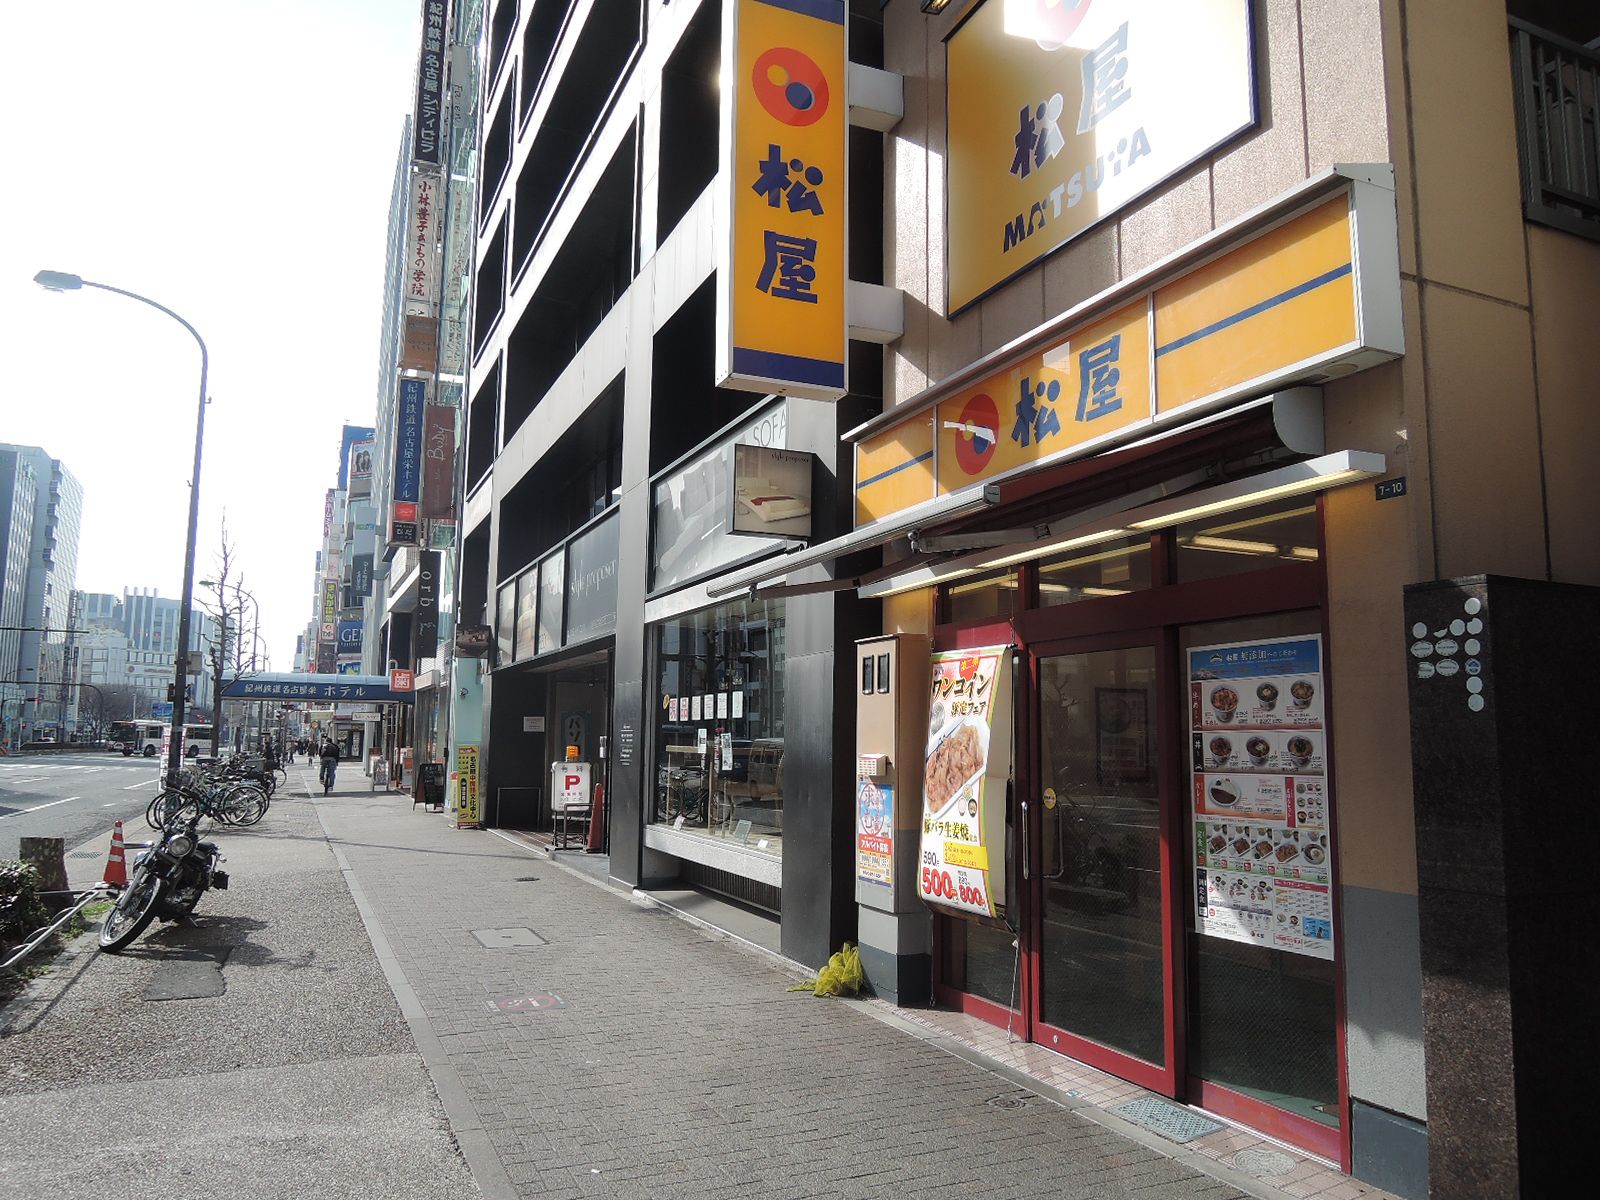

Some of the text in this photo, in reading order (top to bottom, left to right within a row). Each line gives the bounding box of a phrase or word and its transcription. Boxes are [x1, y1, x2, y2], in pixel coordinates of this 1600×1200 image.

[1009, 20, 1132, 180] 松屋
[751, 144, 824, 304] 松屋
[1002, 126, 1151, 254] MATSUYA
[401, 382, 419, 499] 紀州鉄道名古屋栄ホテル
[1011, 333, 1123, 450] 松屋
[1379, 482, 1402, 495] 7-10
[324, 685, 366, 697] ホテル
[932, 672, 991, 700] ワンコイン
[565, 775, 580, 790] P
